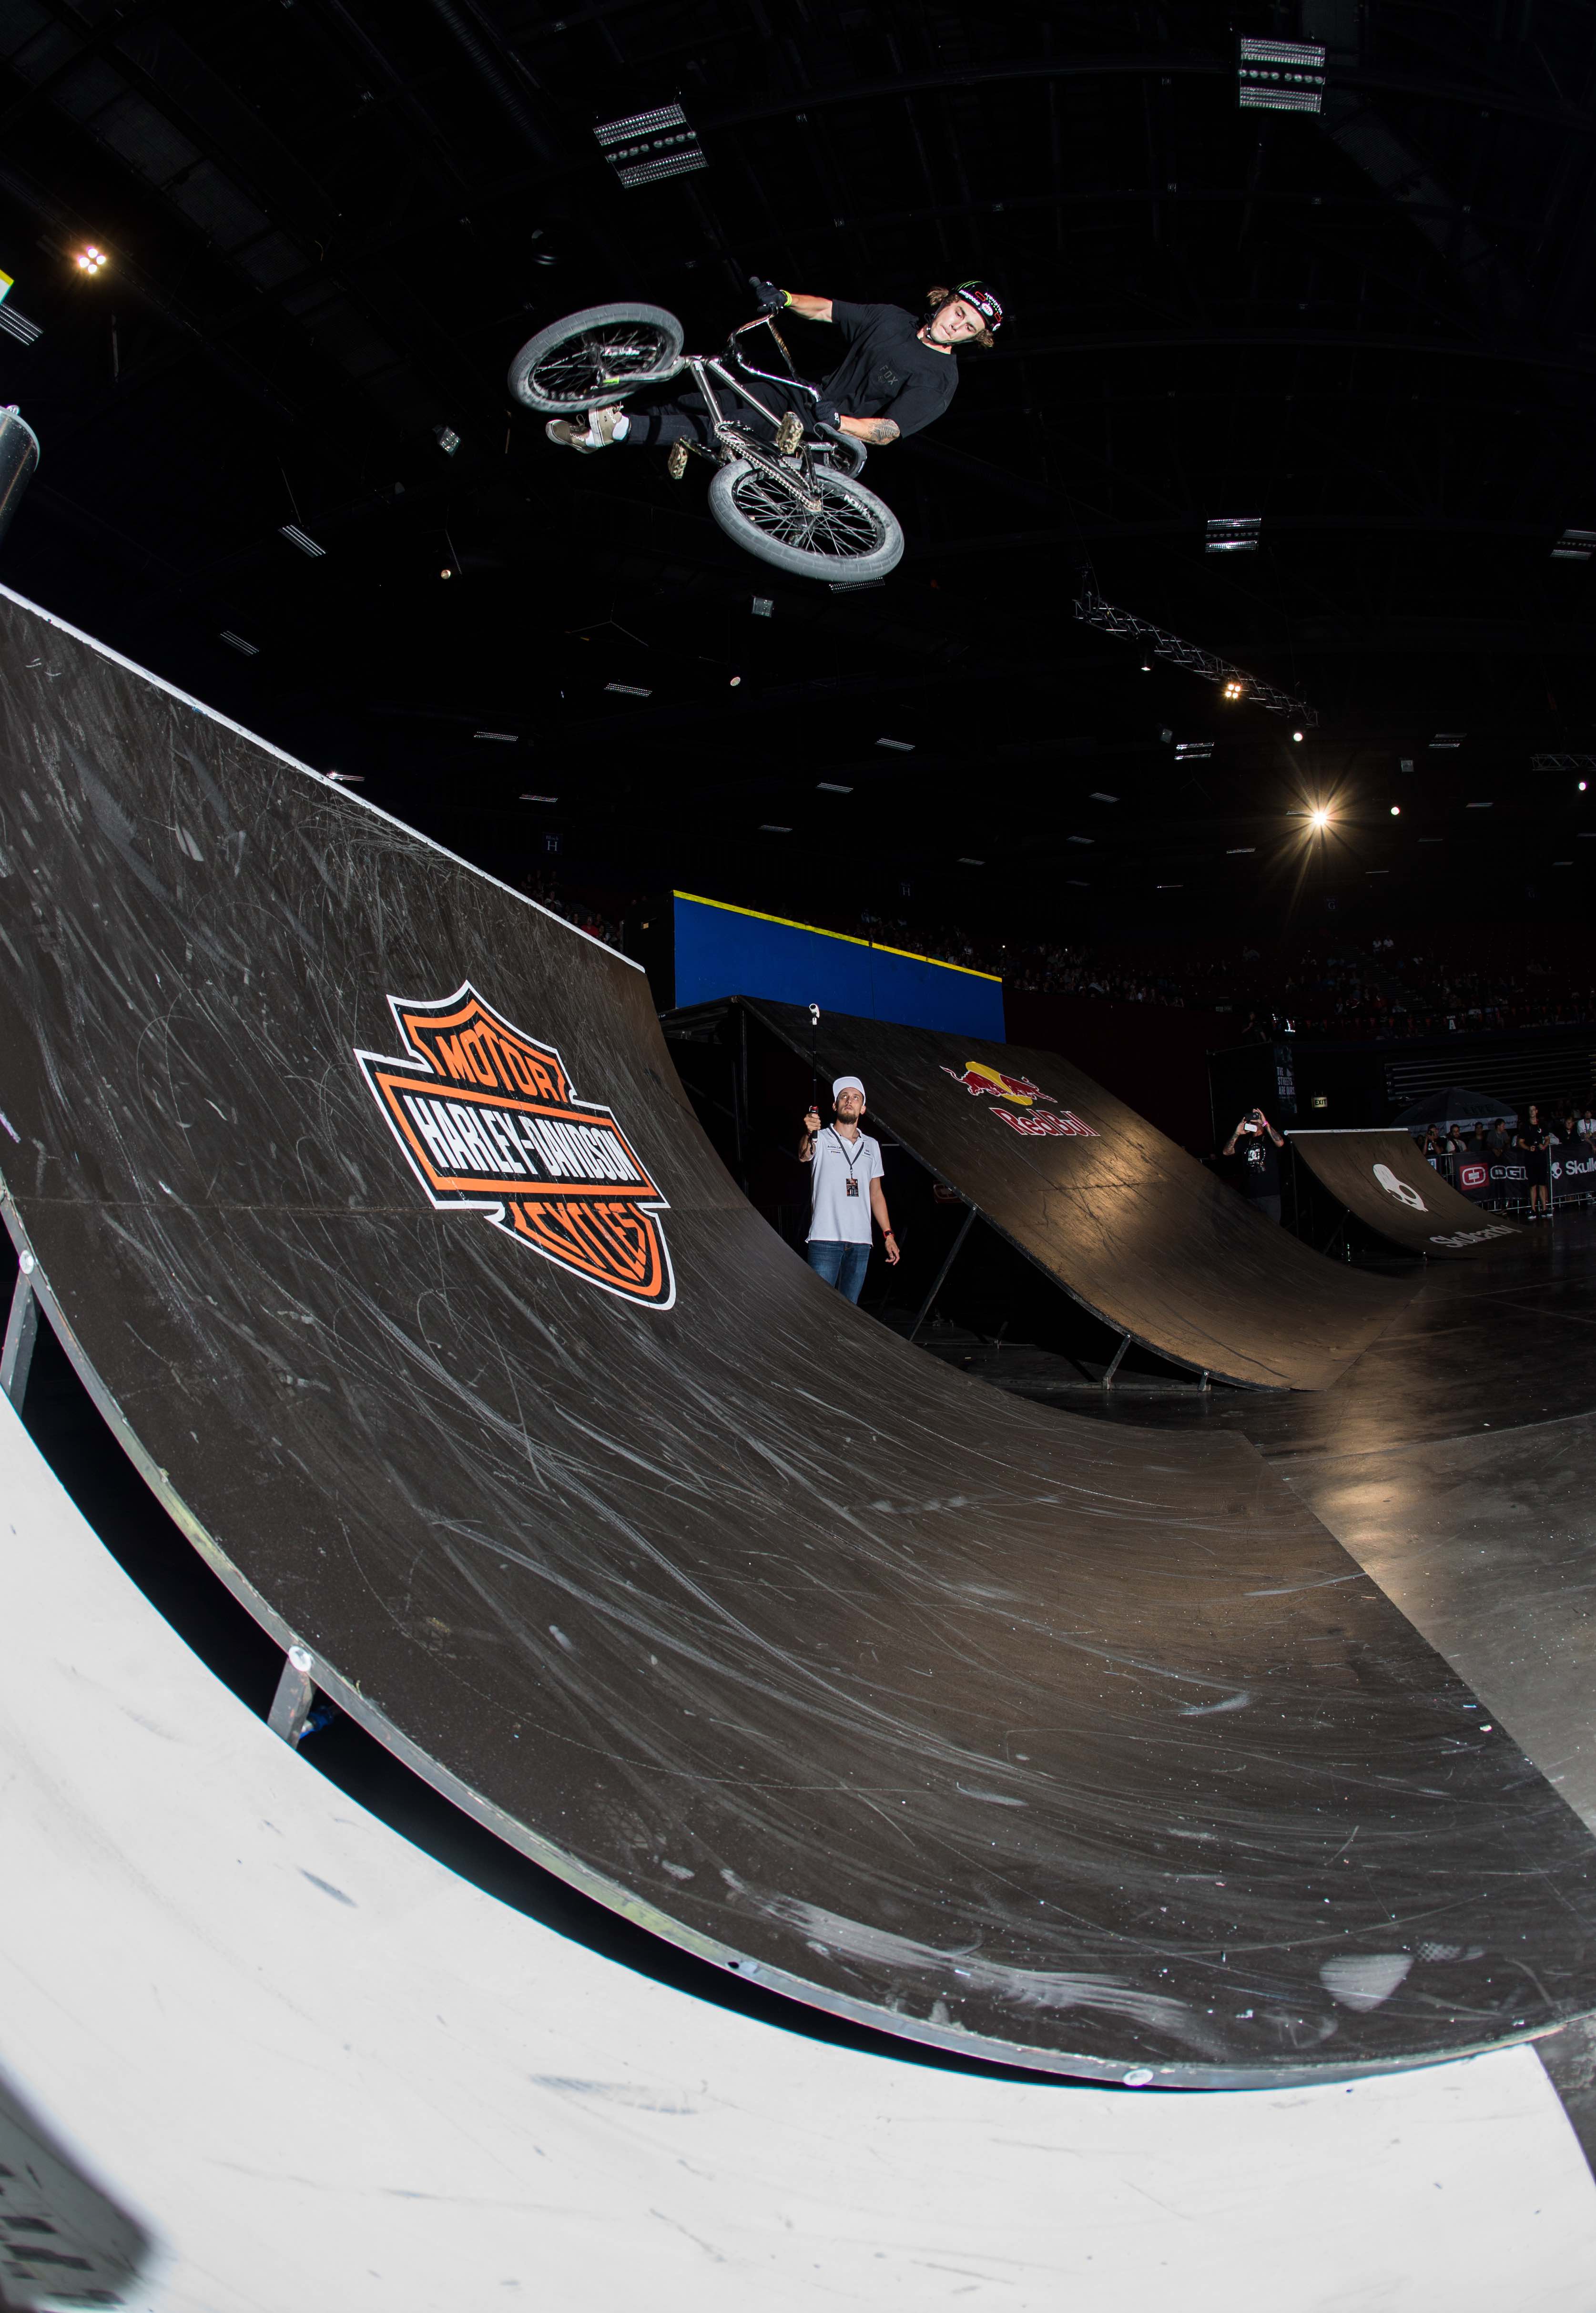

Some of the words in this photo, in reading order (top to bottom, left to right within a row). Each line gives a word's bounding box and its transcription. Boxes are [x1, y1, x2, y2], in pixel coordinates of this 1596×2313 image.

[879, 365, 898, 386] FOX
[547, 840, 558, 851] H
[436, 1019, 559, 1100] MOTOR
[403, 1095, 641, 1181] HARLEY-DAVIDSON
[1490, 1165, 1528, 1181] OGI
[523, 1202, 647, 1281] CYCLES
